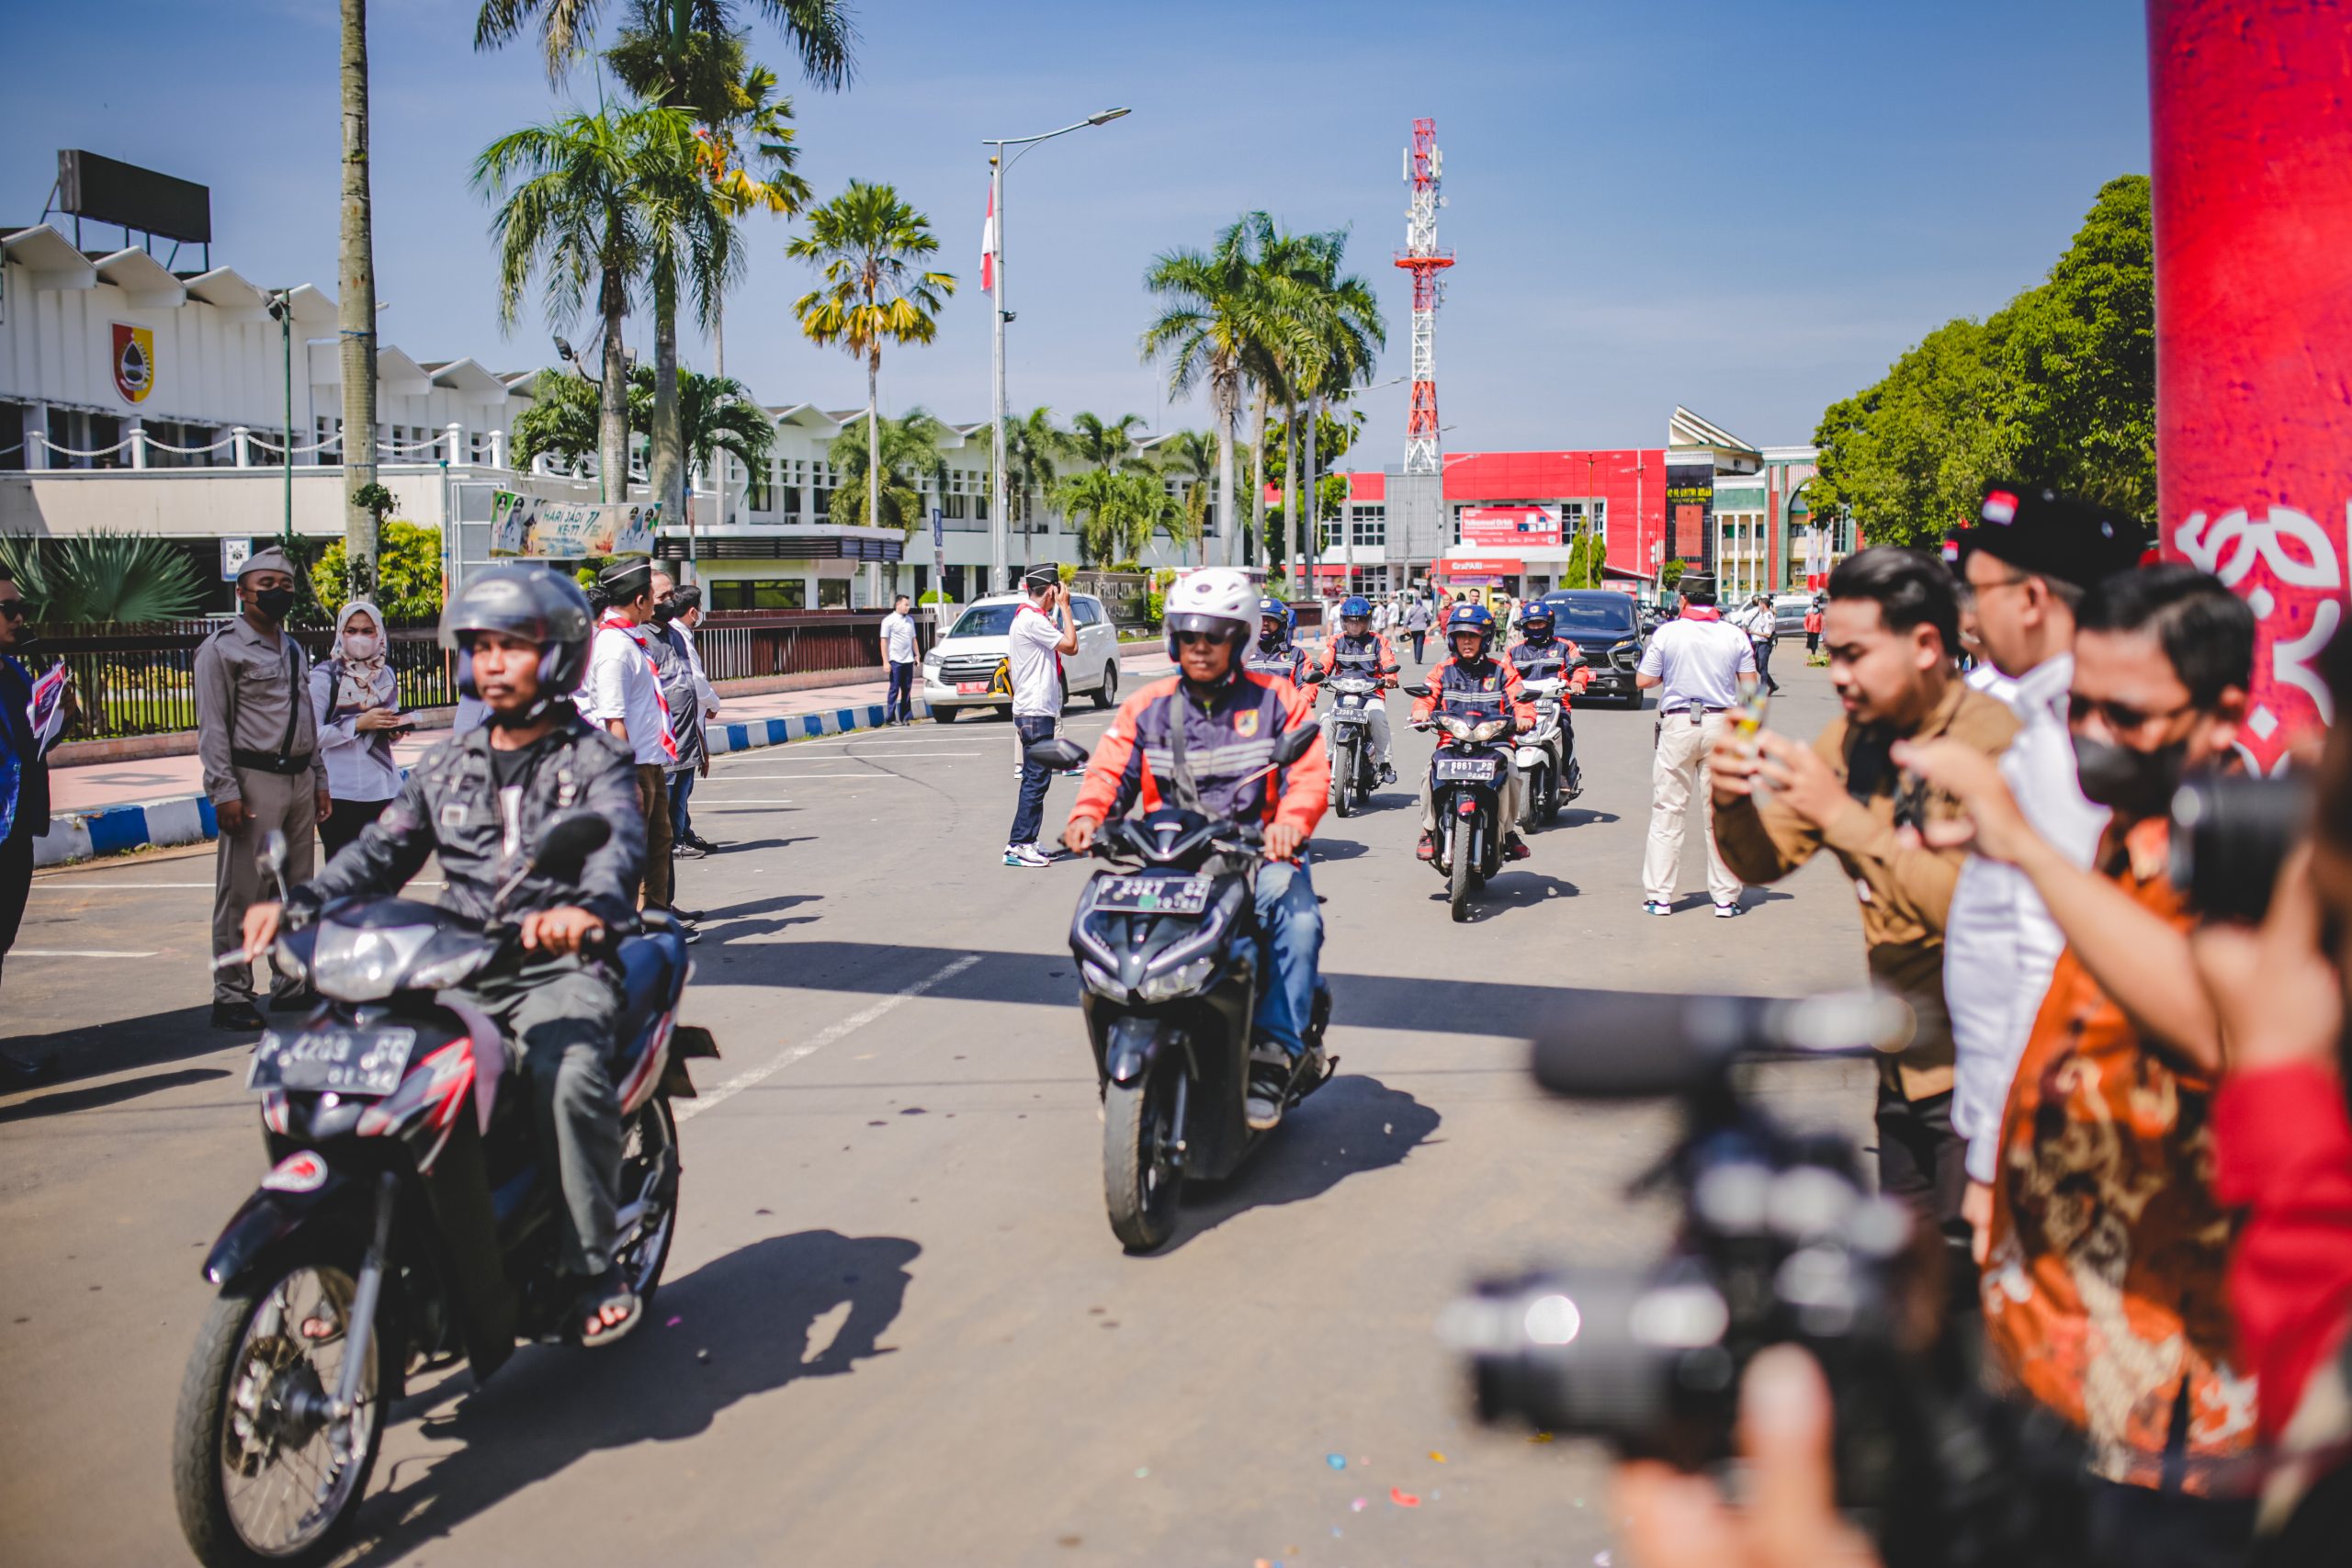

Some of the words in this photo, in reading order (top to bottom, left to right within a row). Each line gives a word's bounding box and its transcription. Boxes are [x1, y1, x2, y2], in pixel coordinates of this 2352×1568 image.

[543, 510, 562, 524] HARI
[563, 511, 583, 524] JADI
[557, 524, 581, 536] KE-77
[1452, 561, 1483, 570] GraPARI
[1439, 761, 1445, 770] P
[1100, 880, 1114, 895] P
[1121, 879, 1165, 896] 2327
[260, 1032, 282, 1061] P
